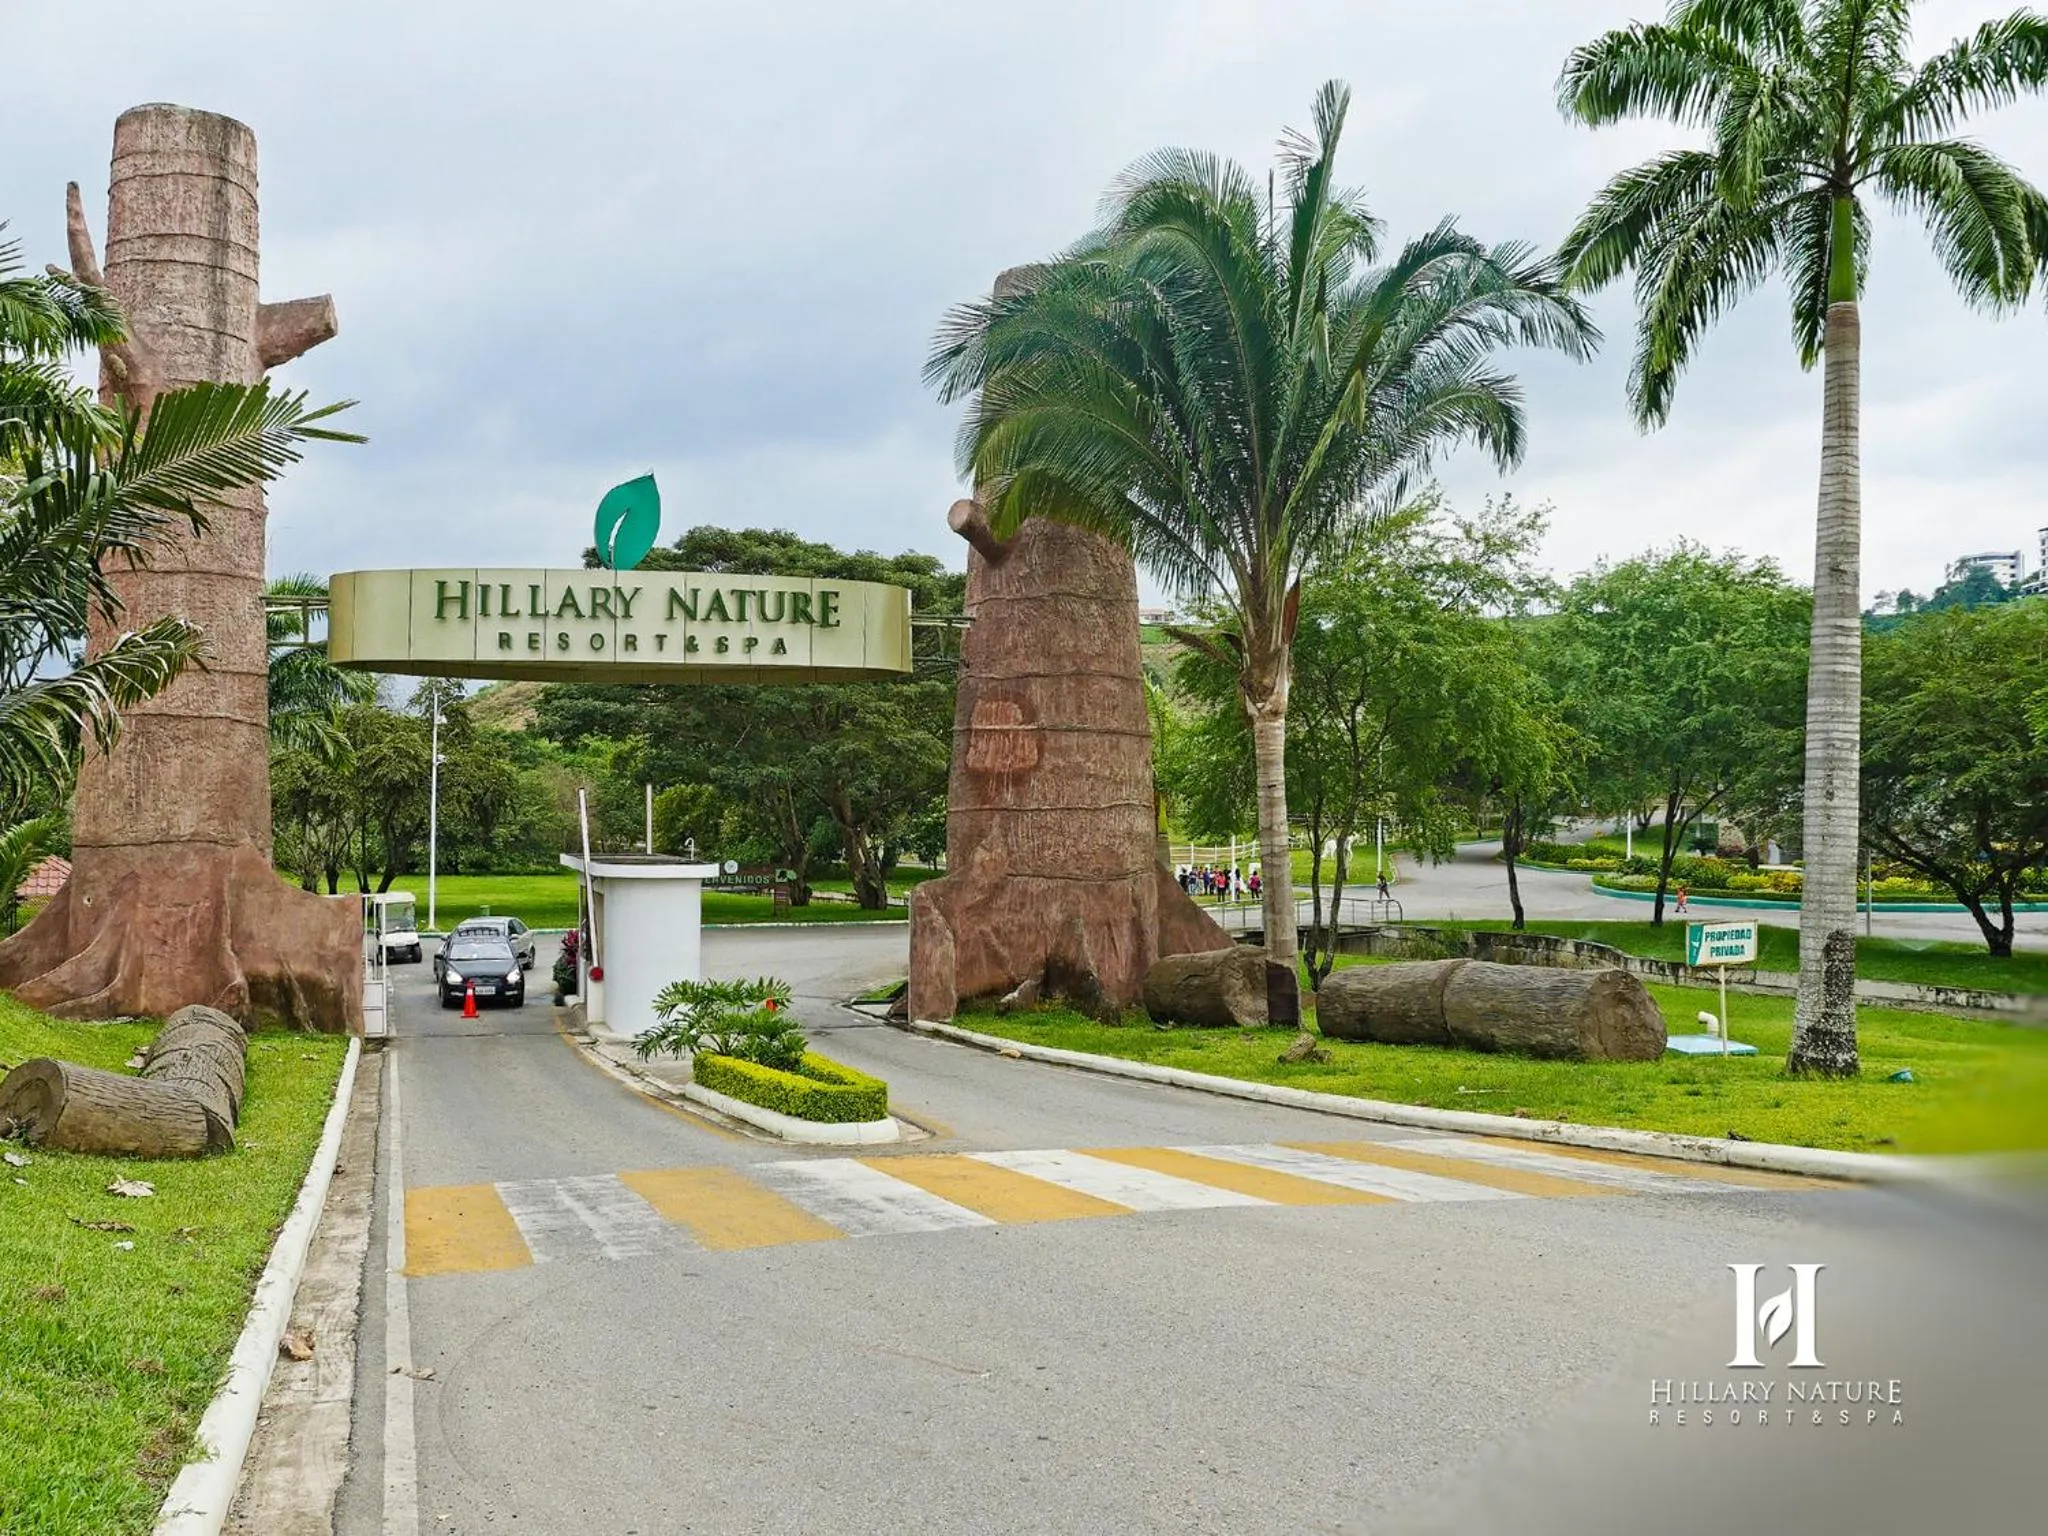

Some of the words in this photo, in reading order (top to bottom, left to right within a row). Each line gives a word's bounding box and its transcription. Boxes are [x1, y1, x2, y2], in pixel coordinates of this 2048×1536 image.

[435, 580, 641, 620] HILLARY
[665, 587, 841, 628] NATURE
[704, 875, 770, 884] ENVENIDOS
[1704, 928, 1752, 942] PROPIEDAD
[1710, 944, 1746, 958] PRIVADA
